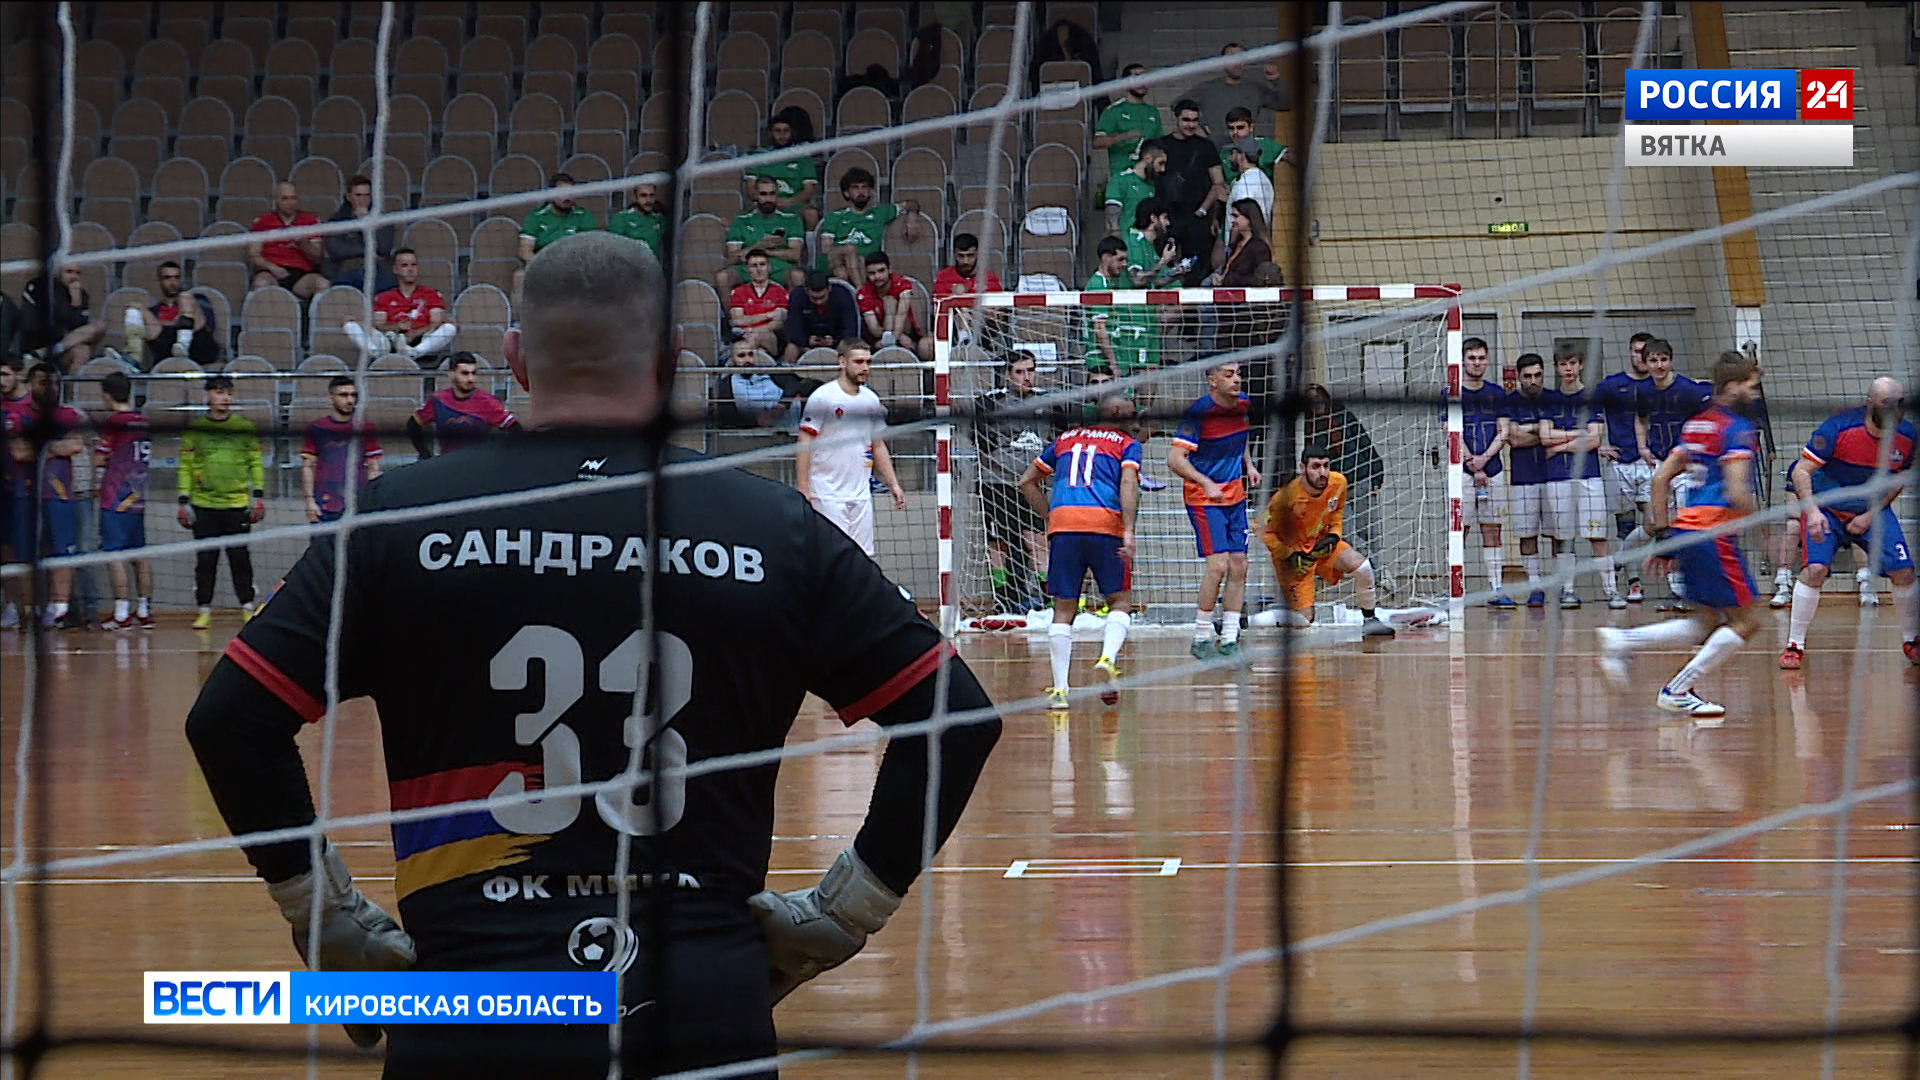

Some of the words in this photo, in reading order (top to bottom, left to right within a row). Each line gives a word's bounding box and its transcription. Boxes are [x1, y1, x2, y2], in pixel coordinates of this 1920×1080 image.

[1069, 443, 1097, 487] 11
[418, 529, 765, 582] САНДРАКОВ
[1895, 543, 1908, 560] 3
[489, 624, 694, 836] 33
[482, 875, 552, 902] ФК
